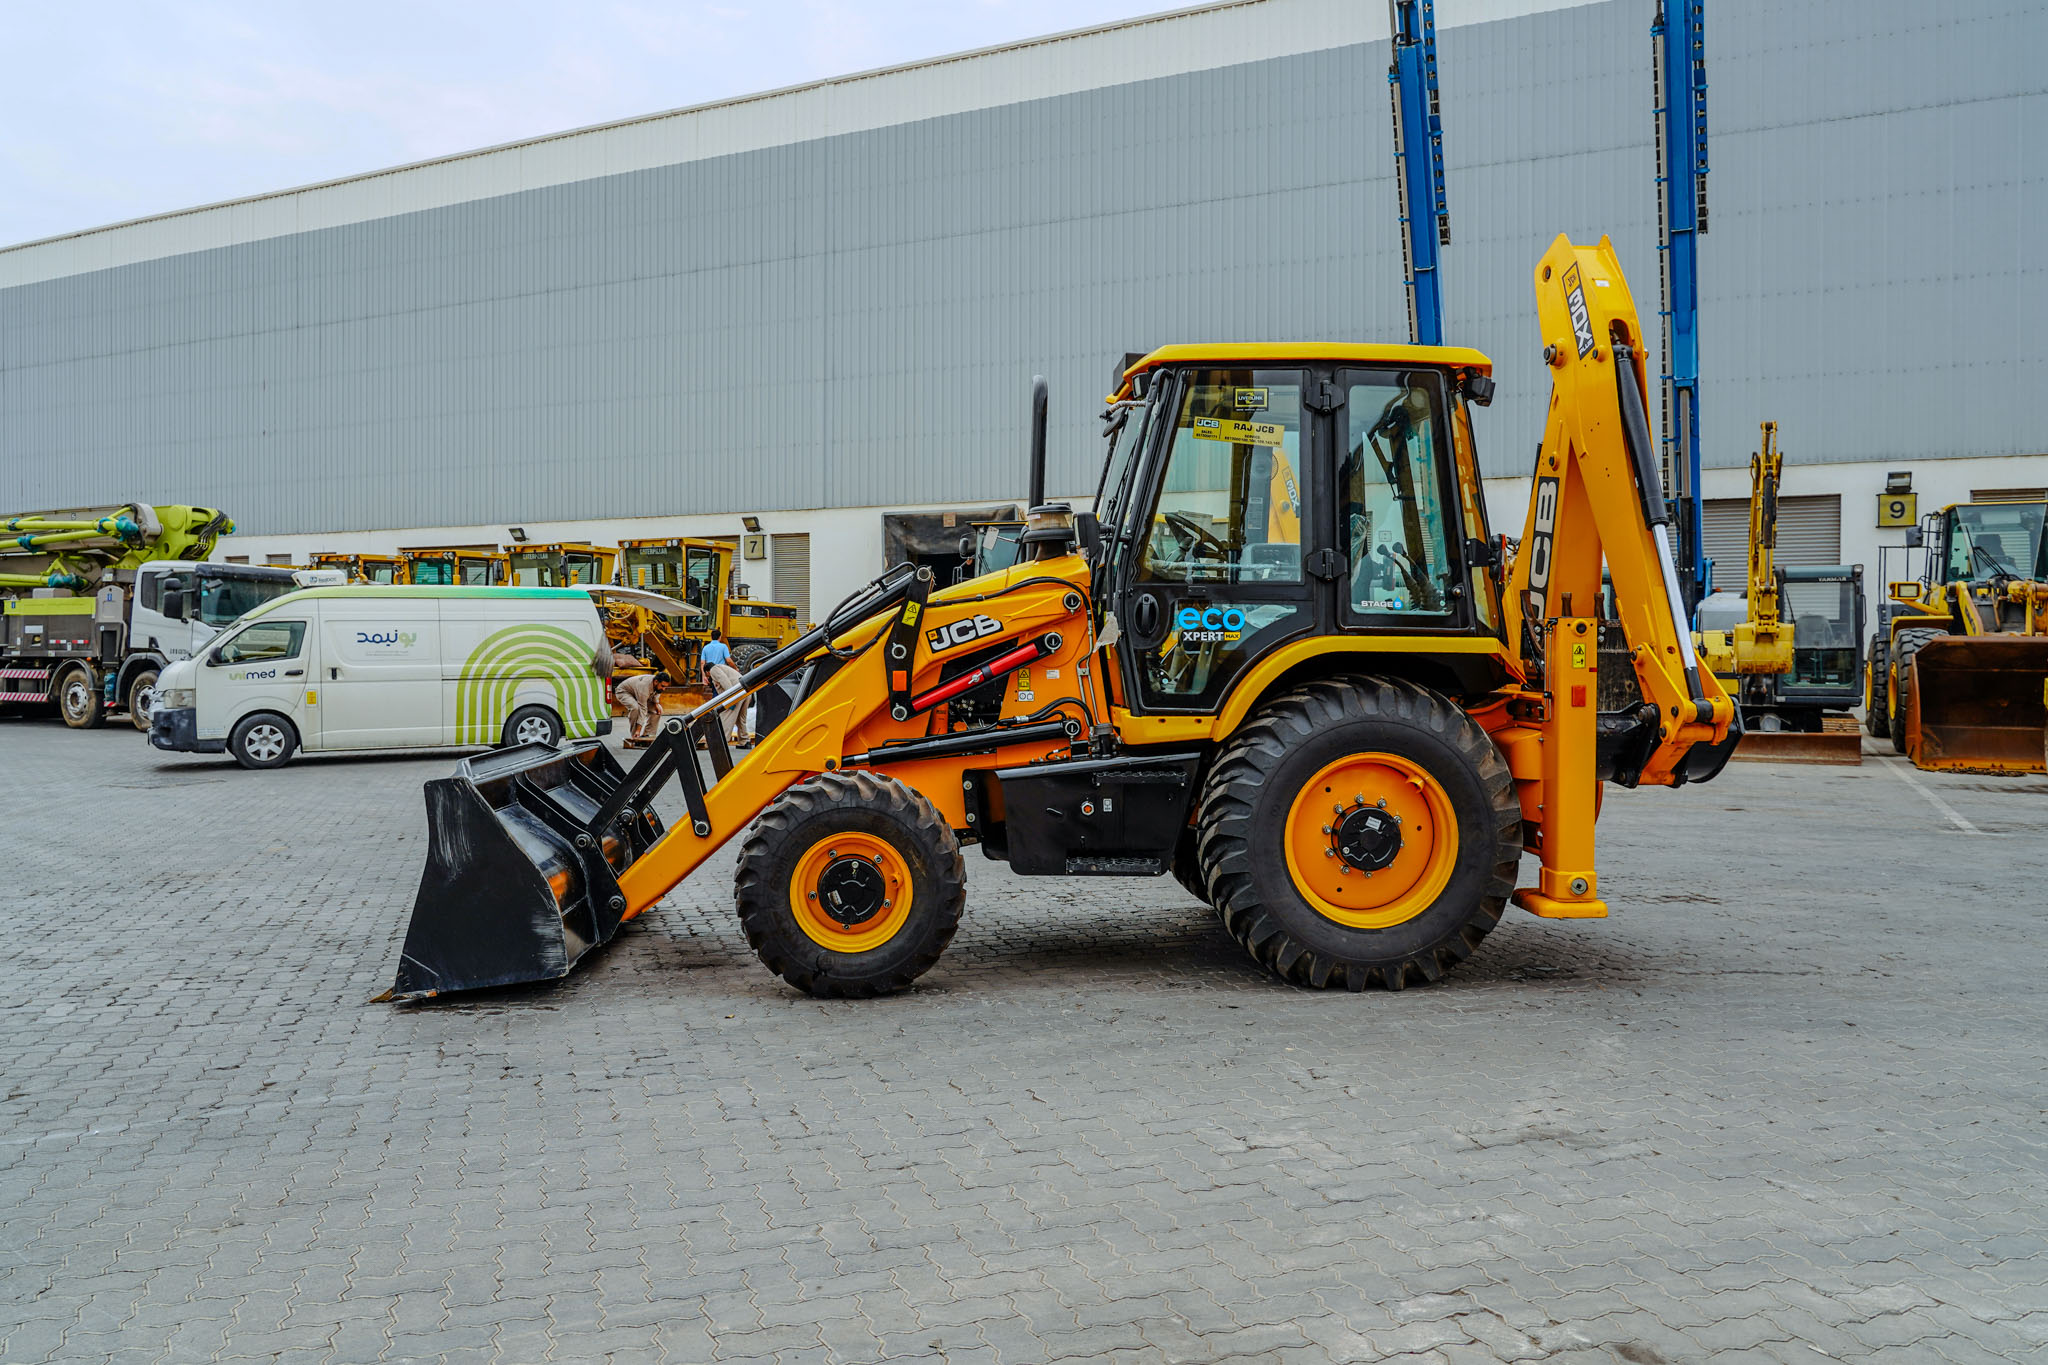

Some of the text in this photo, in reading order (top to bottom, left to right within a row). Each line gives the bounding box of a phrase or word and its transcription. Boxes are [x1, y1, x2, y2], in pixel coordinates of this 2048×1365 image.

[1569, 287, 1593, 350] 3DX
[1197, 420, 1219, 428] JCB
[1233, 422, 1275, 434] RAJ JCB
[1890, 500, 1905, 519] 9
[749, 540, 758, 554] 7
[1361, 600, 1393, 608] STAGE
[741, 605, 752, 617] CAT
[1178, 607, 1245, 631] eco
[357, 629, 416, 648] يونيمد
[930, 614, 1001, 651] JCB
[1183, 631, 1223, 641] XPERT
[229, 669, 276, 680] unimed
